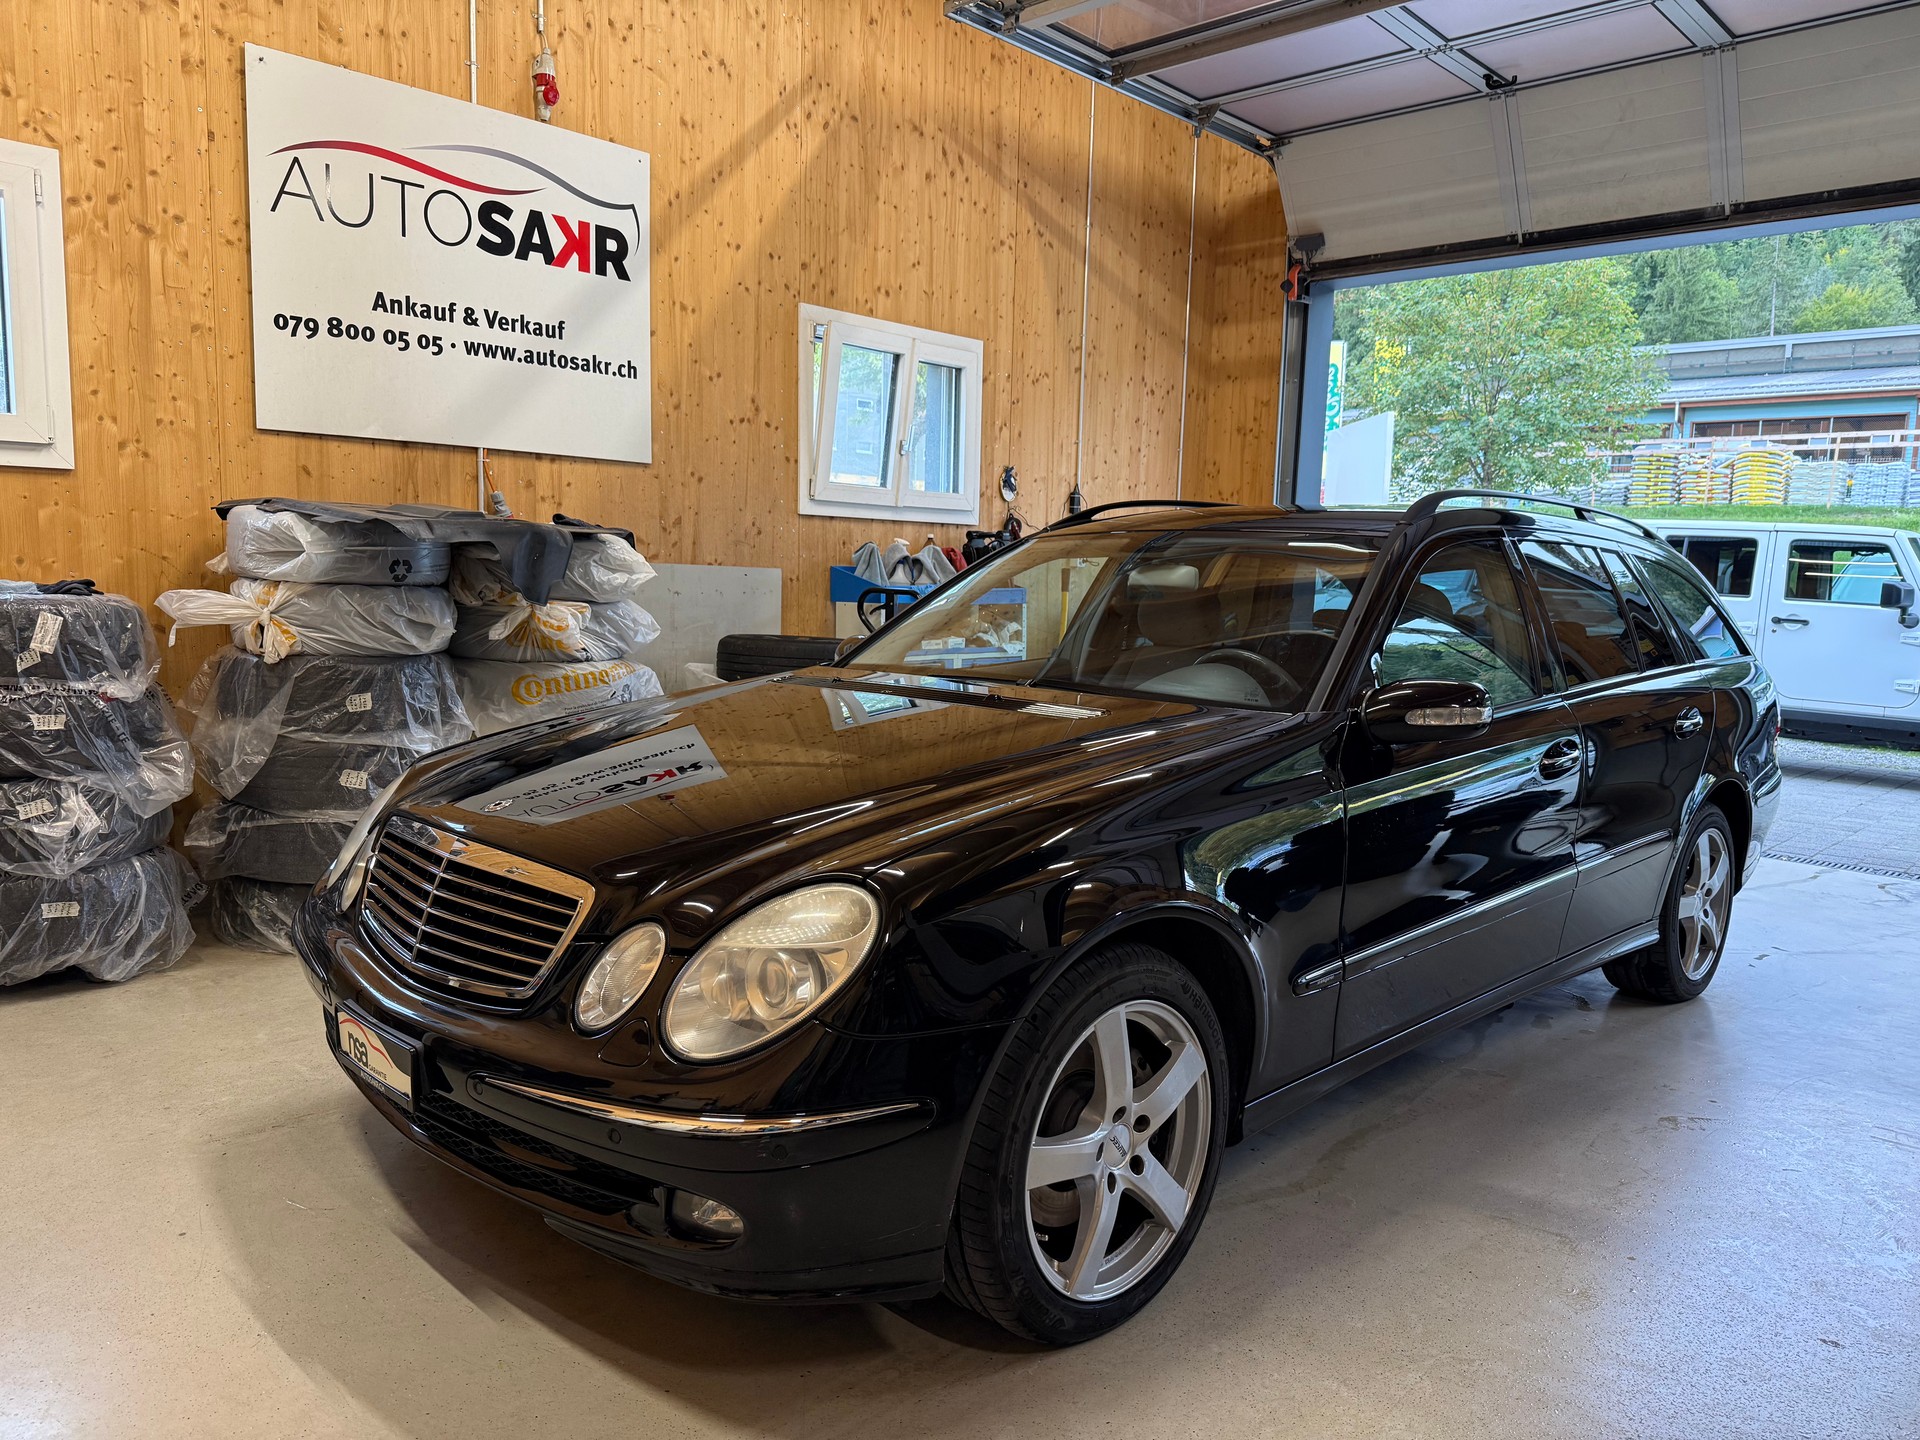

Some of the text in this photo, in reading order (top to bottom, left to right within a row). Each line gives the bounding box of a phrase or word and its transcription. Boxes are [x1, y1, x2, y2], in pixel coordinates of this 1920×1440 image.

[270, 156, 631, 282] AUTOSAKR
[372, 291, 566, 340] Ankauf & Verkauf
[273, 313, 319, 340] 079
[327, 316, 375, 343] 800
[382, 329, 411, 352] 05
[417, 333, 444, 356] 05
[464, 340, 638, 380] www.autosakr.ch
[347, 1030, 369, 1070] nsa
